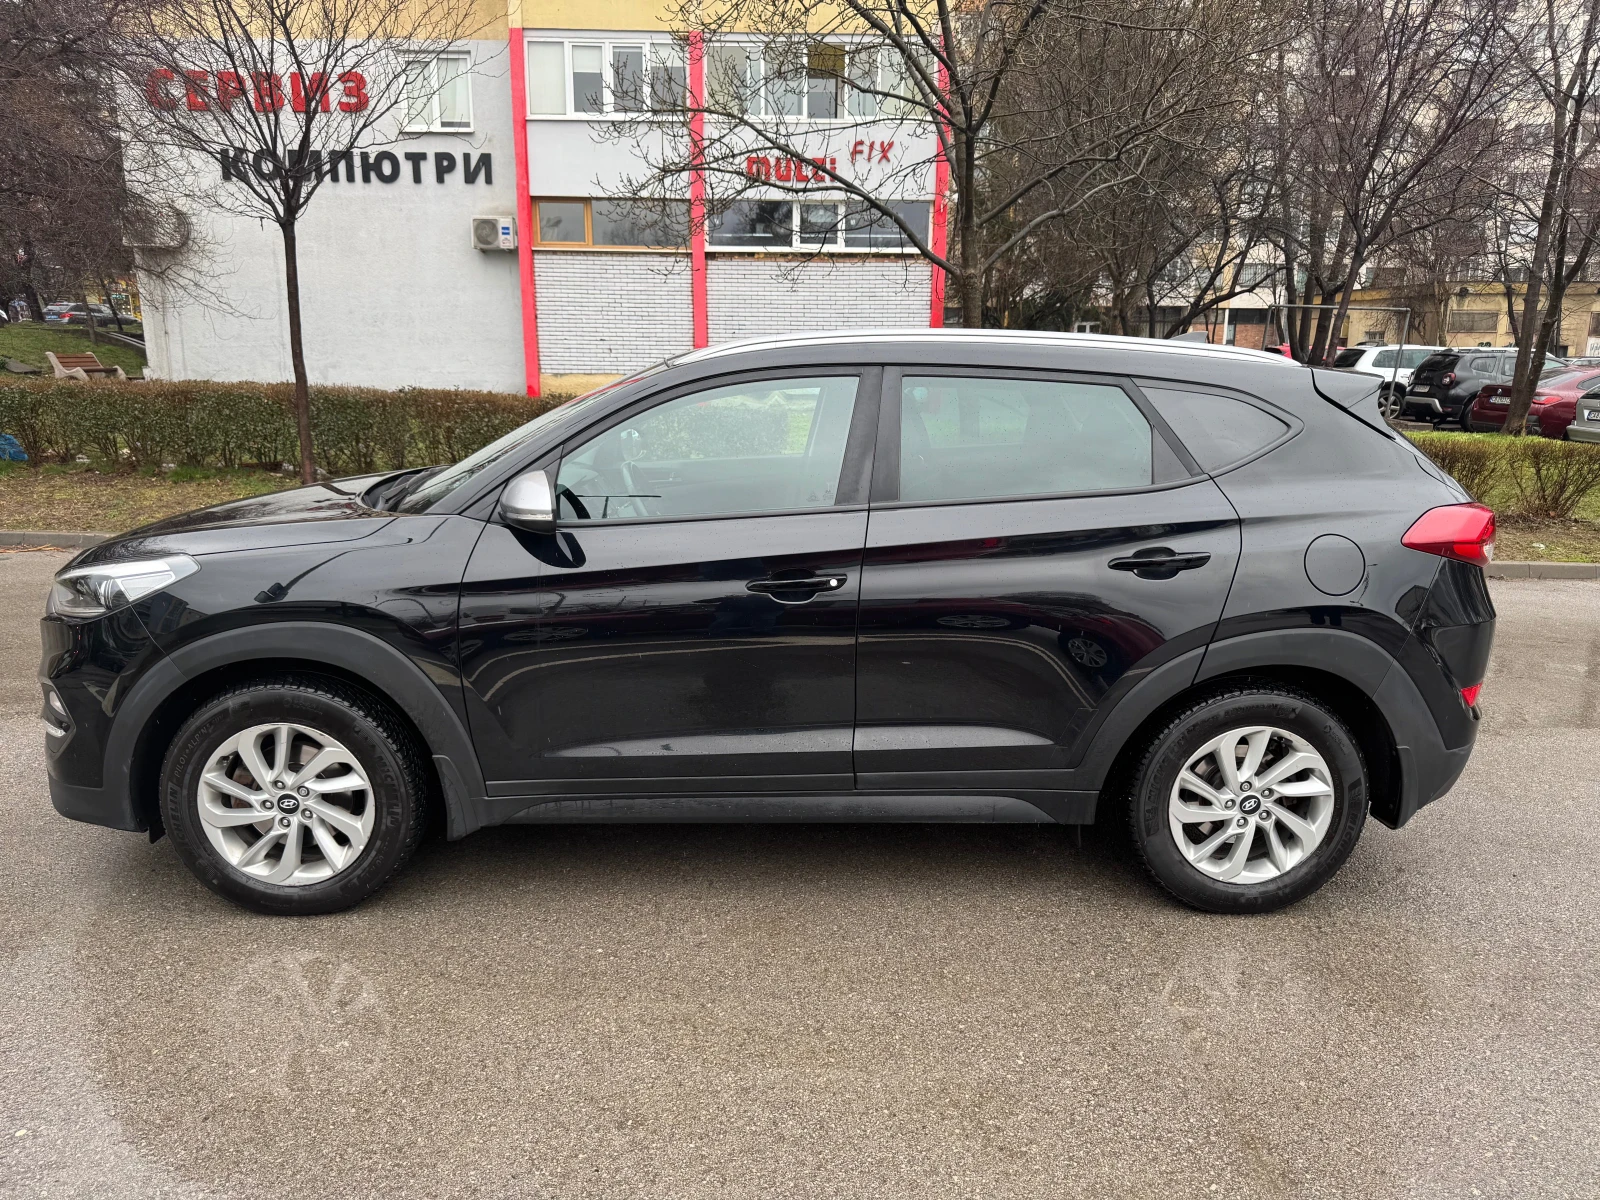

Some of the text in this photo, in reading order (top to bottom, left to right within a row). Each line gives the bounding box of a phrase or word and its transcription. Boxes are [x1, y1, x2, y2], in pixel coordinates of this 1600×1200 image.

[147, 69, 369, 112] СЕРВИЗ
[219, 149, 493, 184] КОМПЮТРИ
[851, 140, 894, 164] FIX
